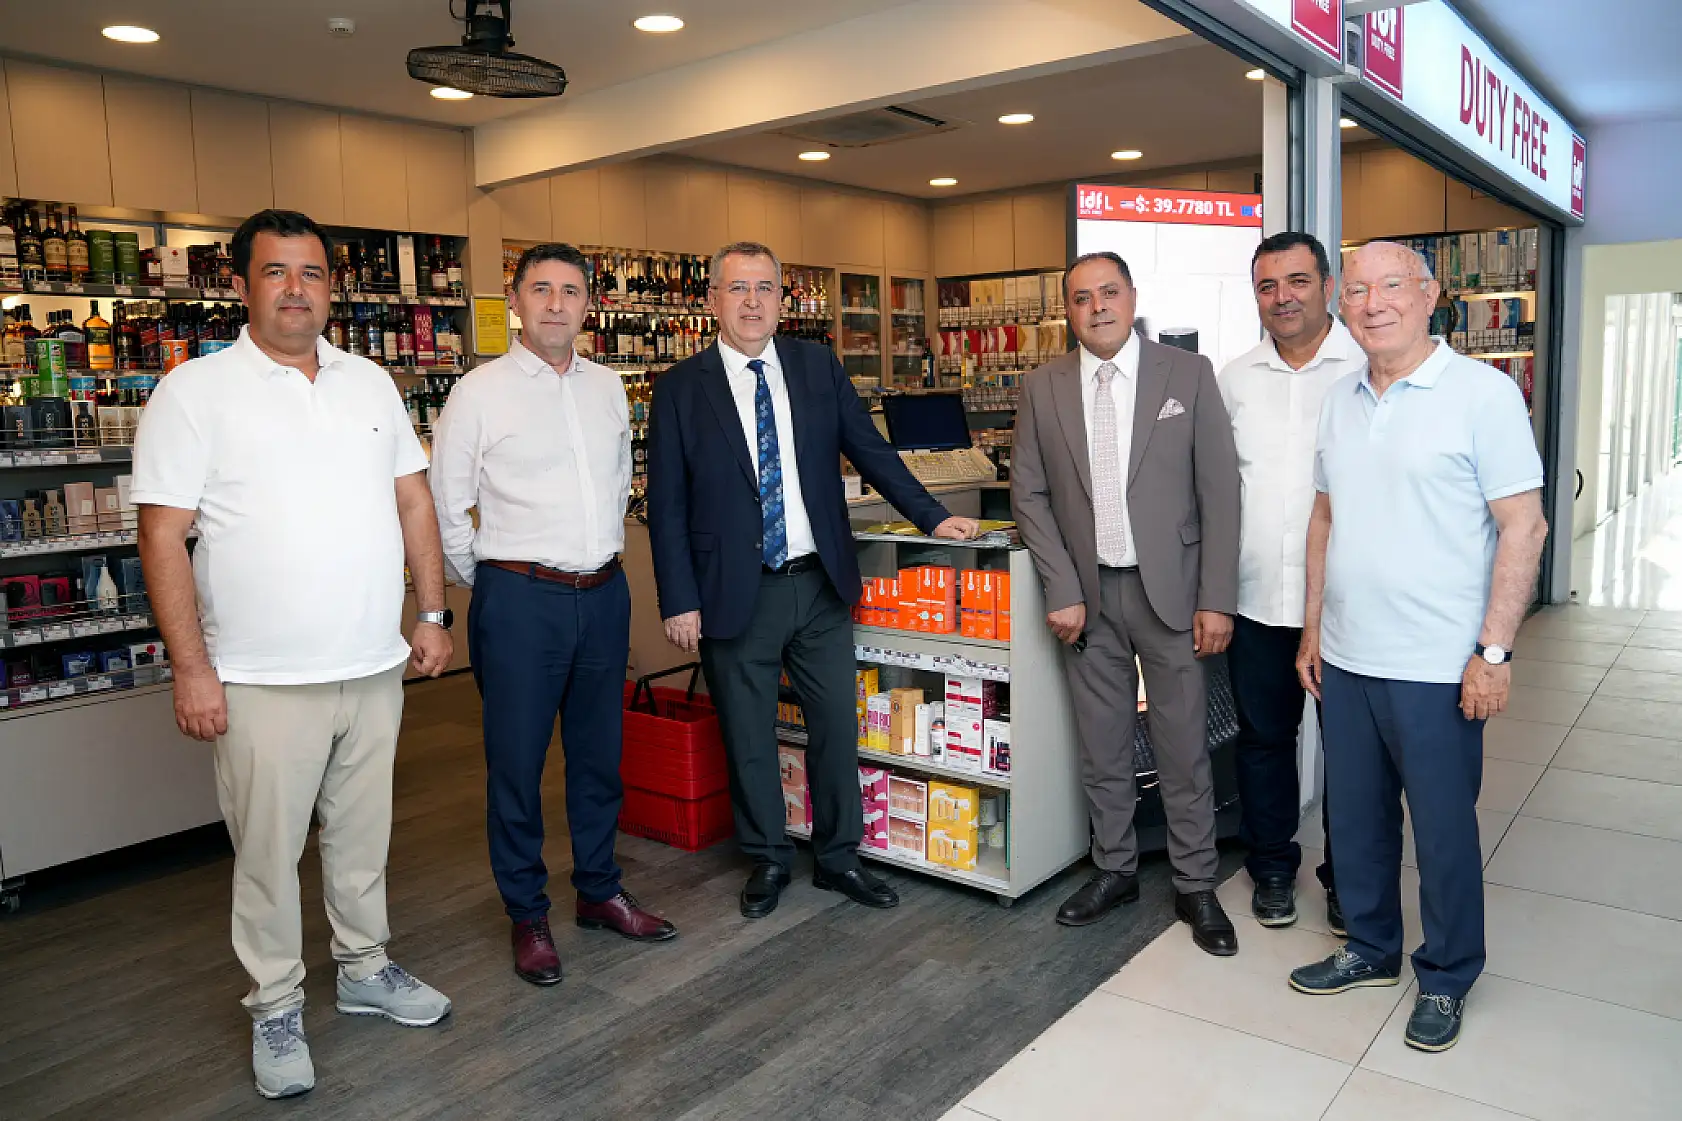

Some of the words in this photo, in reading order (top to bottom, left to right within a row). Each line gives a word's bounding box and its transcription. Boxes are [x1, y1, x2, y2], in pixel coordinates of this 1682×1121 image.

[1460, 43, 1509, 152] DUTY
[1511, 91, 1549, 182] FREE
[1080, 190, 1103, 210] idf
[1153, 197, 1214, 215] 39.7780
[1215, 201, 1235, 217] TL
